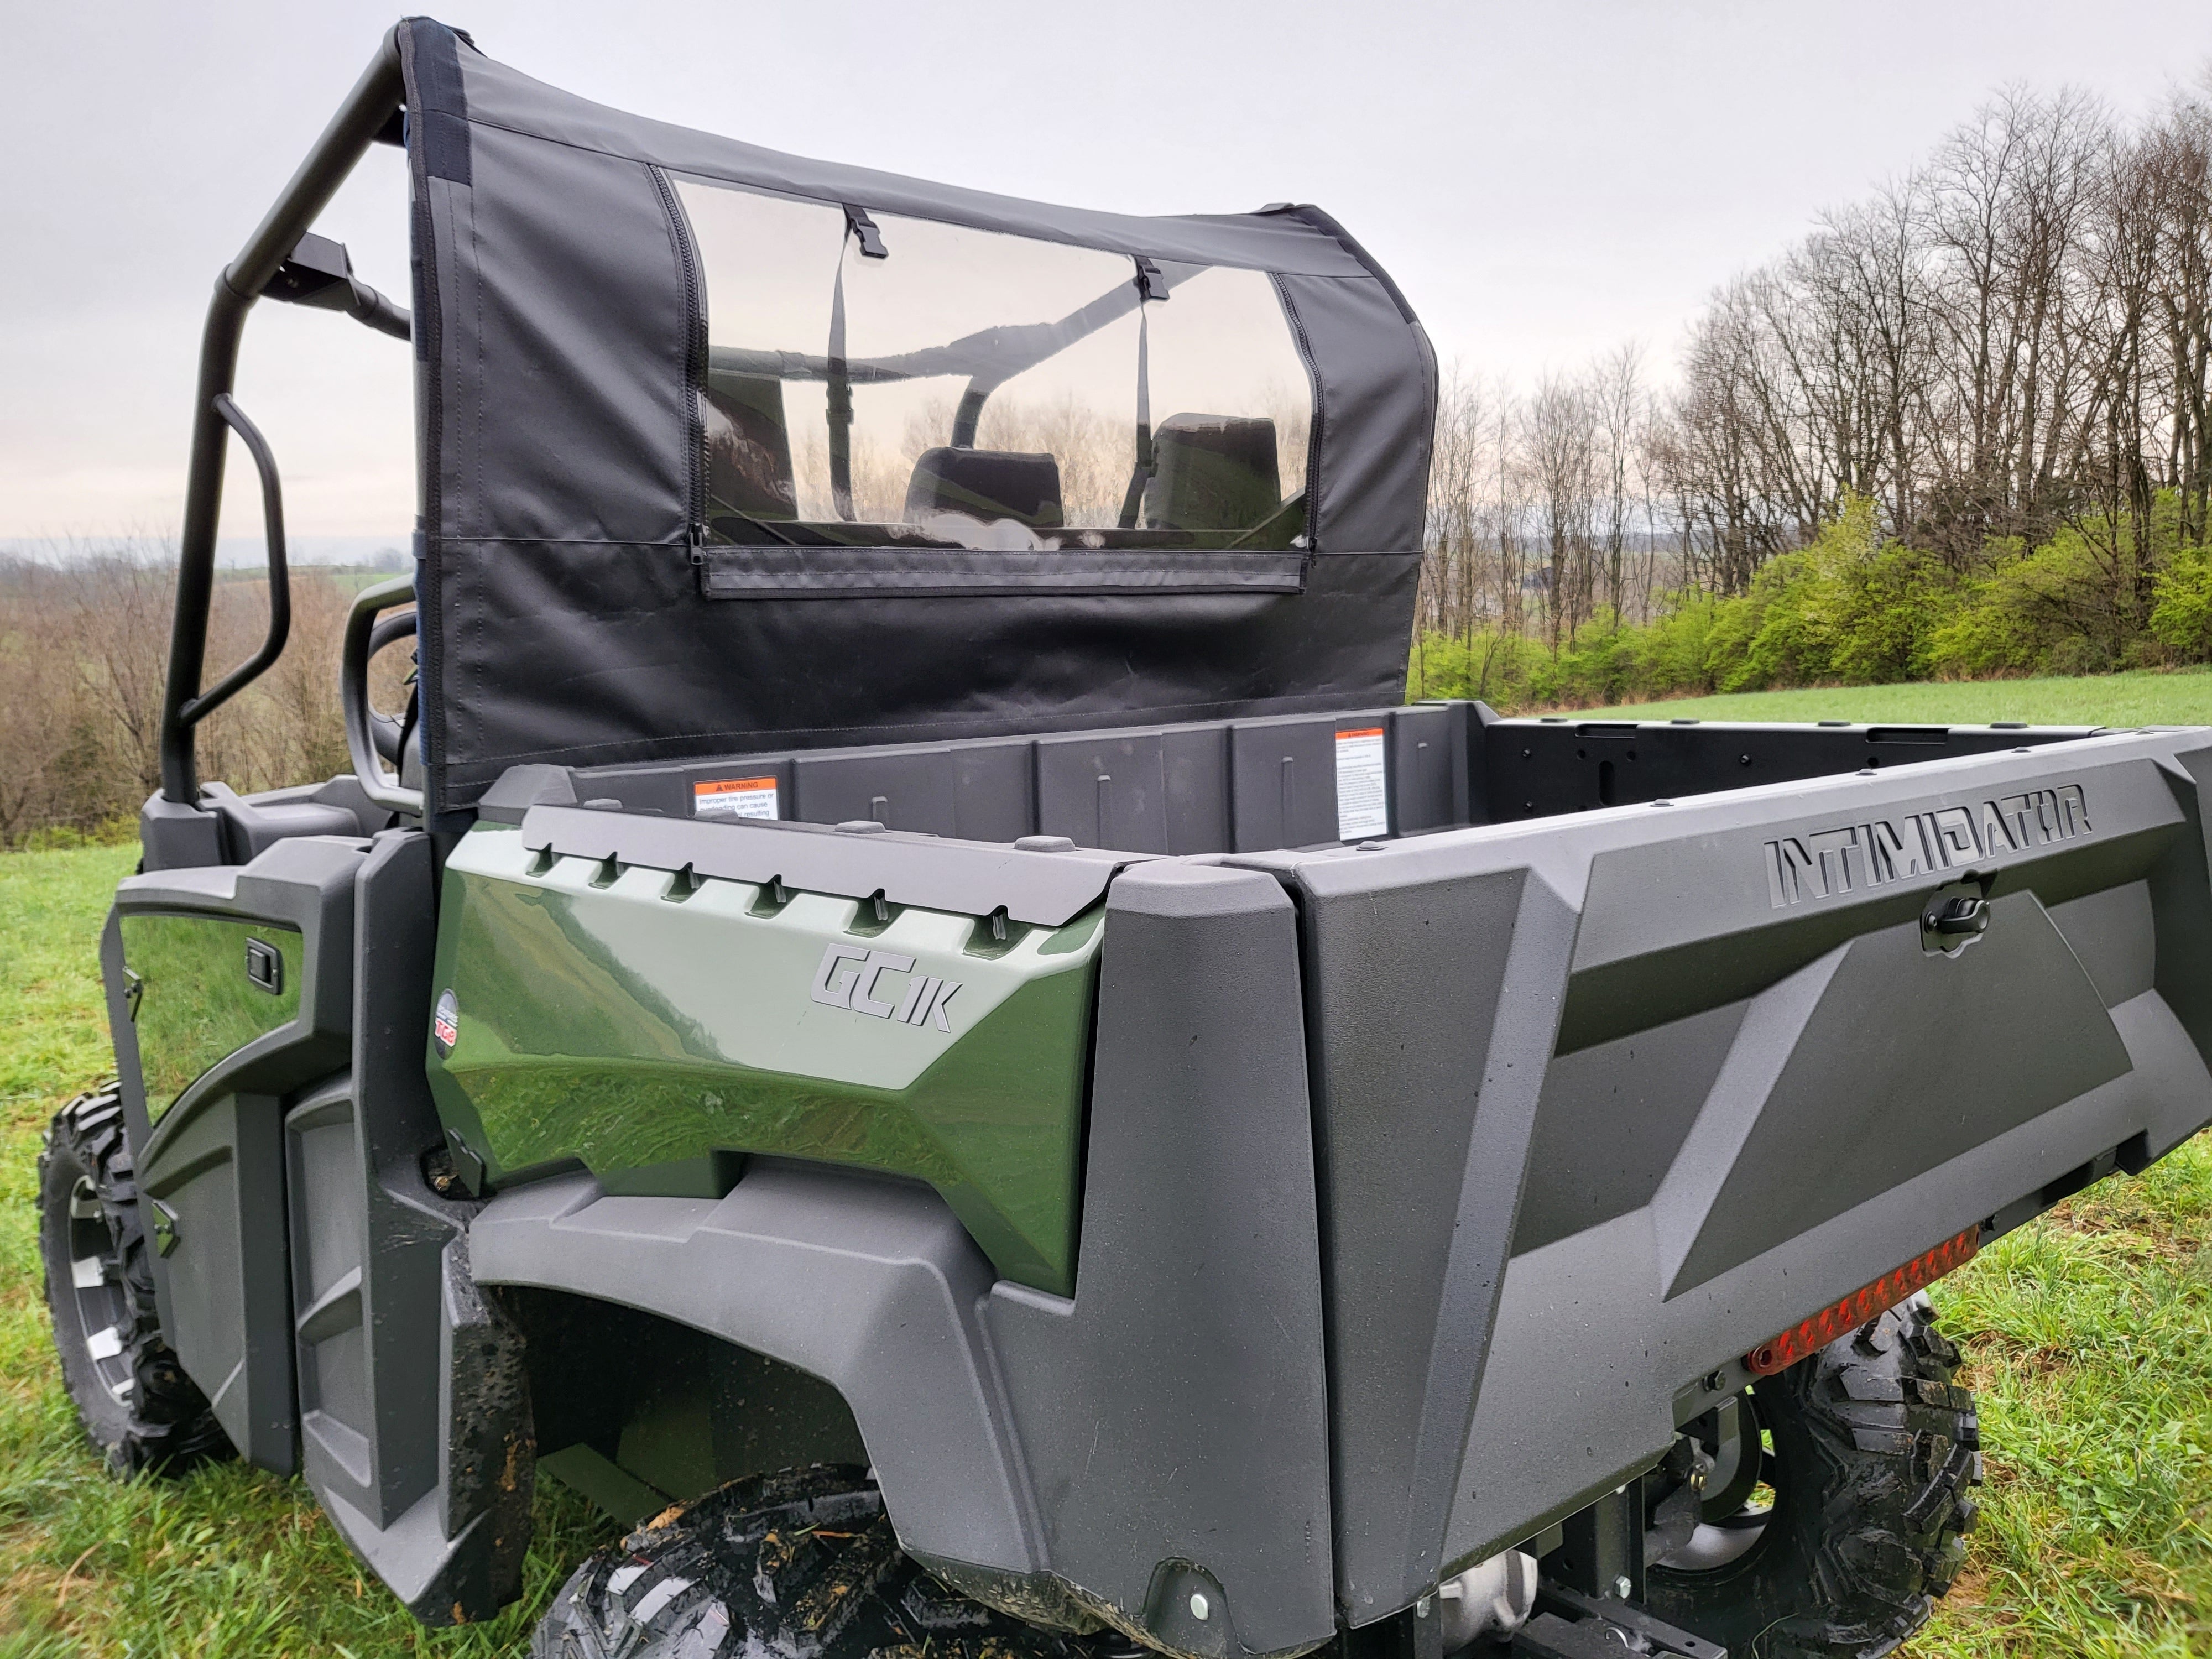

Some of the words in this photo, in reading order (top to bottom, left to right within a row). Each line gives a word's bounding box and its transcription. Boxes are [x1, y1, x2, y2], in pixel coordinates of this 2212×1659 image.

[724, 782, 758, 790] WARNING
[740, 794, 766, 802] pressure
[1764, 783, 2093, 909] INTIMIDATOR
